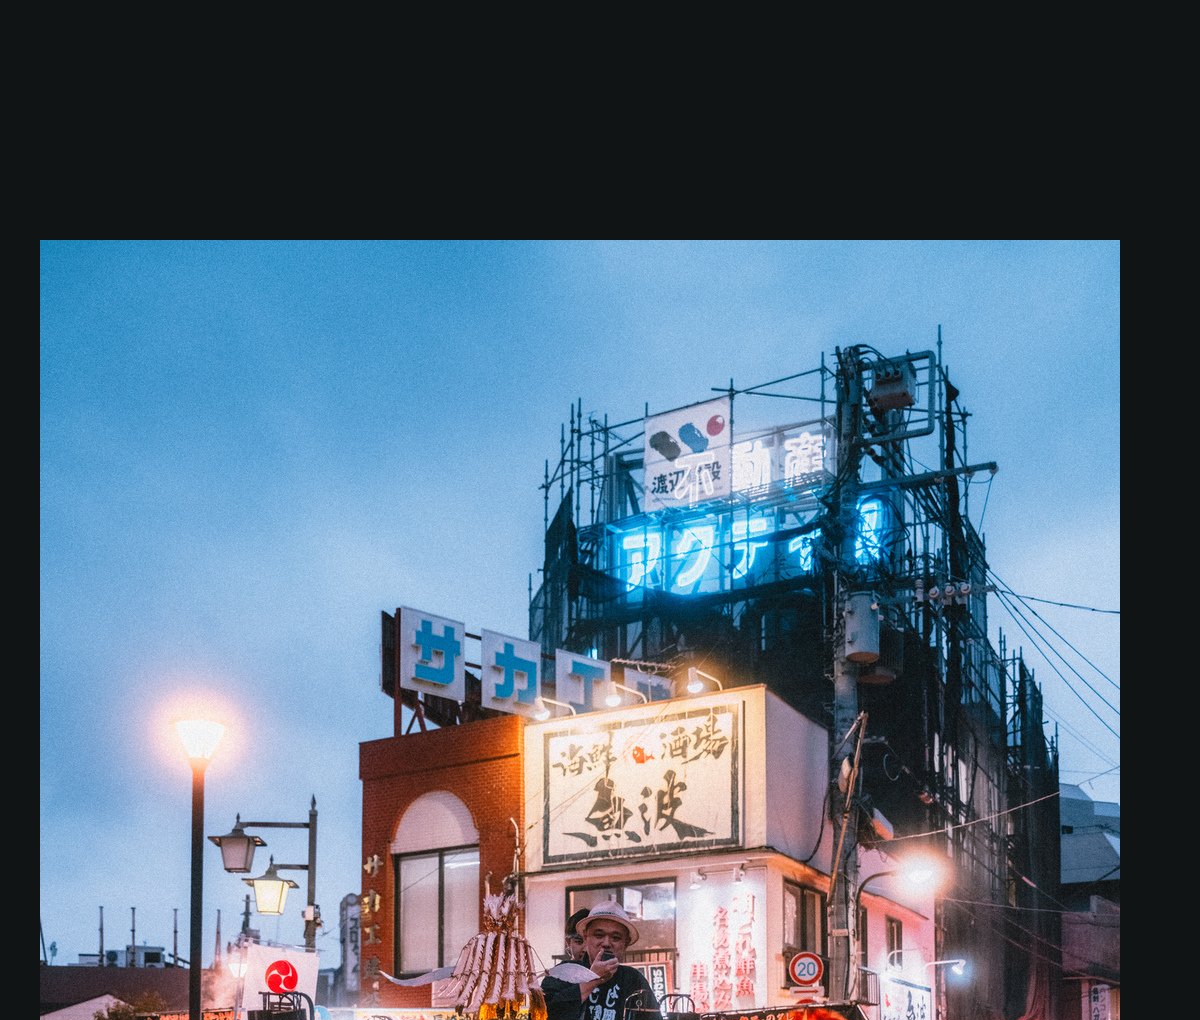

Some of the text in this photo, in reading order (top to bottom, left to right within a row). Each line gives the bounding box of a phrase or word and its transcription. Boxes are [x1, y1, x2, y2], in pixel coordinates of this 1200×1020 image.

[415, 620, 672, 715] サカエ
[660, 712, 731, 765] 酒場
[795, 961, 817, 977] 20
